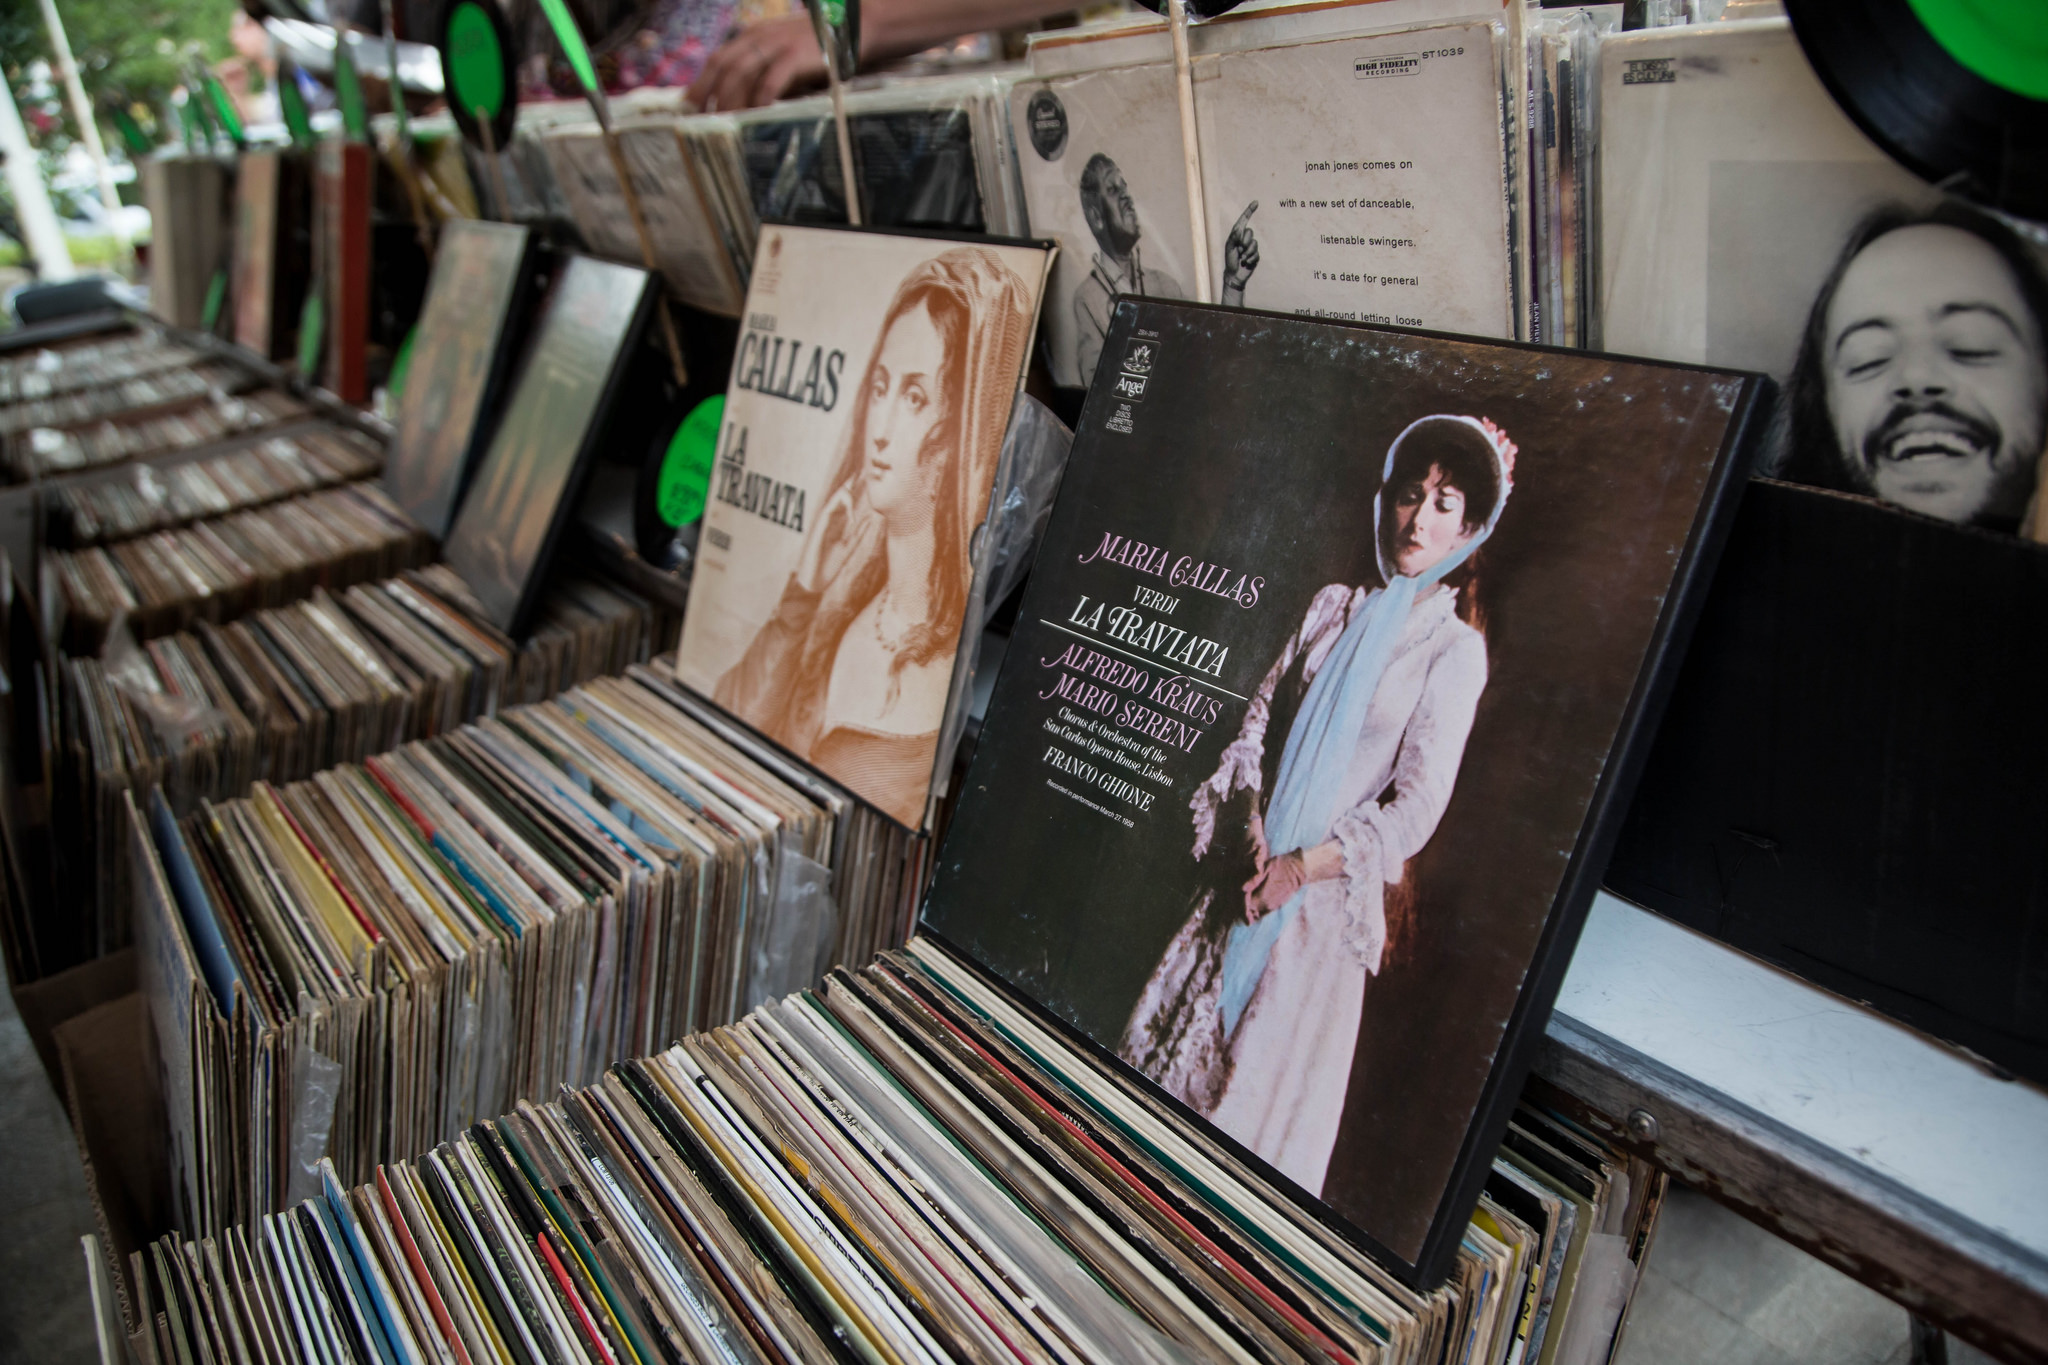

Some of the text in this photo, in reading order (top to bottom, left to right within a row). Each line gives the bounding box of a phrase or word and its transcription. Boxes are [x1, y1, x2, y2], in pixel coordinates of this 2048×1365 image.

[1356, 59, 1419, 72] HIGH FIDELITY
[1366, 68, 1410, 76] RECORDING
[1630, 60, 1669, 72] EL DISCO
[1623, 70, 1676, 82] ES CULTURA
[1305, 160, 1412, 173] jonah jones comes on
[1279, 198, 1297, 208] with
[1331, 199, 1346, 208] set
[1348, 198, 1358, 208] of
[1360, 198, 1415, 210] danceable,
[1320, 234, 1417, 249] listenable swingers.
[1314, 270, 1328, 280] it's
[1340, 272, 1360, 282] date
[1364, 273, 1378, 284] for
[1380, 276, 1419, 287] general
[1294, 308, 1423, 326] and all-round letting loose
[736, 331, 846, 412] CALLAS
[1116, 376, 1146, 396] Angel
[1109, 416, 1134, 426] LIBRETTO
[1116, 410, 1132, 418] DISCS
[1106, 422, 1132, 434] ENCLOSED
[722, 422, 748, 466] LA
[716, 461, 806, 533] TRAVIATA
[1078, 532, 1266, 608] MARIA CALLAS
[1133, 585, 1180, 615] VERDI
[1068, 595, 1229, 678] LA TRAVIATA
[1040, 643, 1224, 725] ALFREDO KRAUS
[1039, 672, 1203, 754] MARIO SERENI
[1058, 706, 1168, 764] Chorus & Orchestra of the
[1042, 717, 1174, 788] San Carlos Opera House, Lisbon
[1042, 746, 1156, 812] FRANCO GHIONE
[1046, 778, 1068, 793] Recorded
[1072, 792, 1100, 811] performance
[1100, 806, 1114, 819] March
[1122, 816, 1134, 828] 1958
